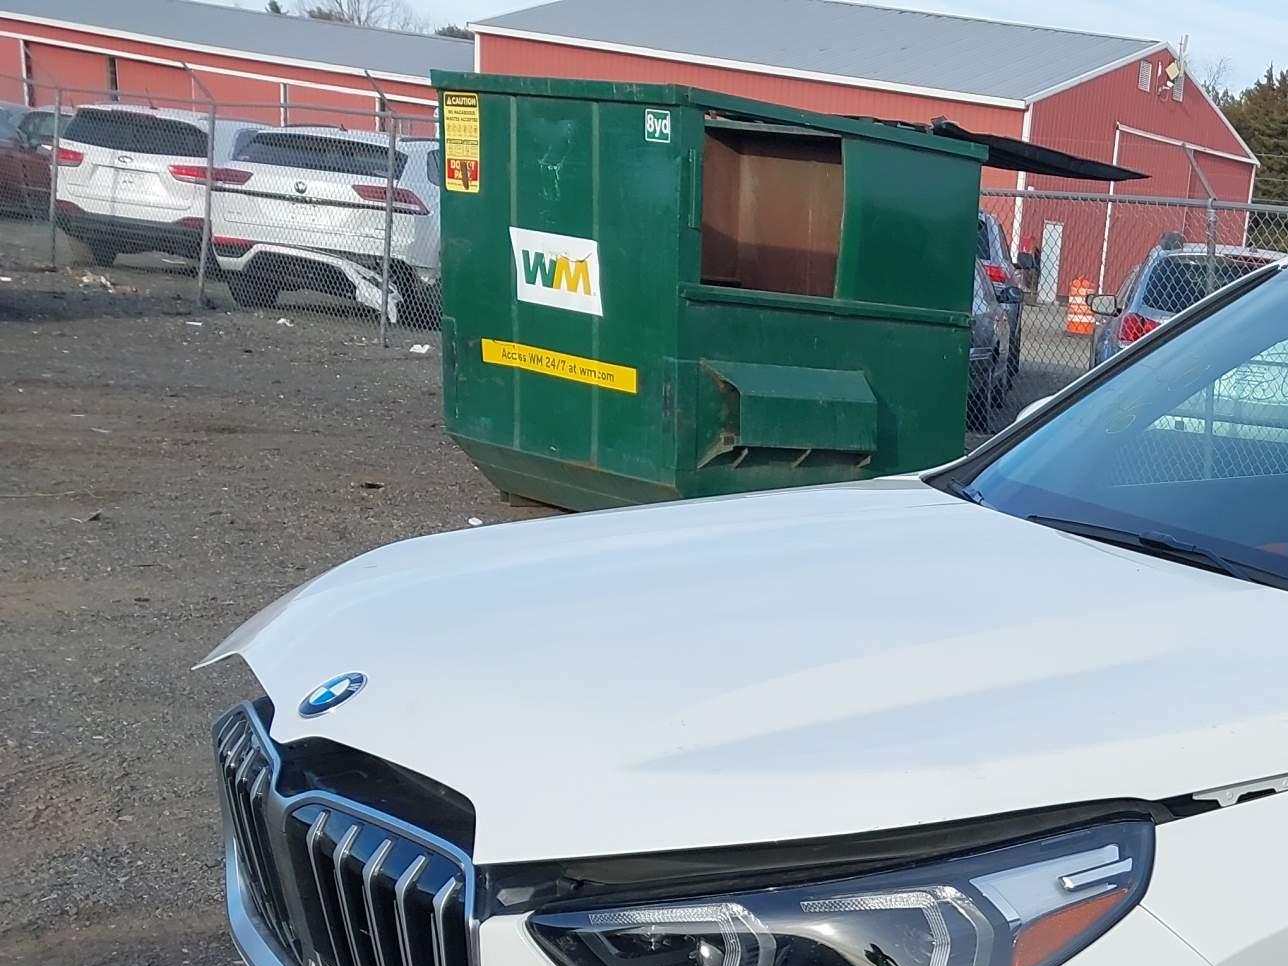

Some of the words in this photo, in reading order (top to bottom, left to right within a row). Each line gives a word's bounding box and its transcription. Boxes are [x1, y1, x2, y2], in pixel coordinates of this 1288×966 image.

[451, 96, 476, 106] CAUTION
[647, 113, 669, 138] 8yd
[522, 249, 592, 295] WM
[528, 352, 543, 366] WM
[545, 356, 566, 371] 24/7
[568, 363, 577, 374] at
